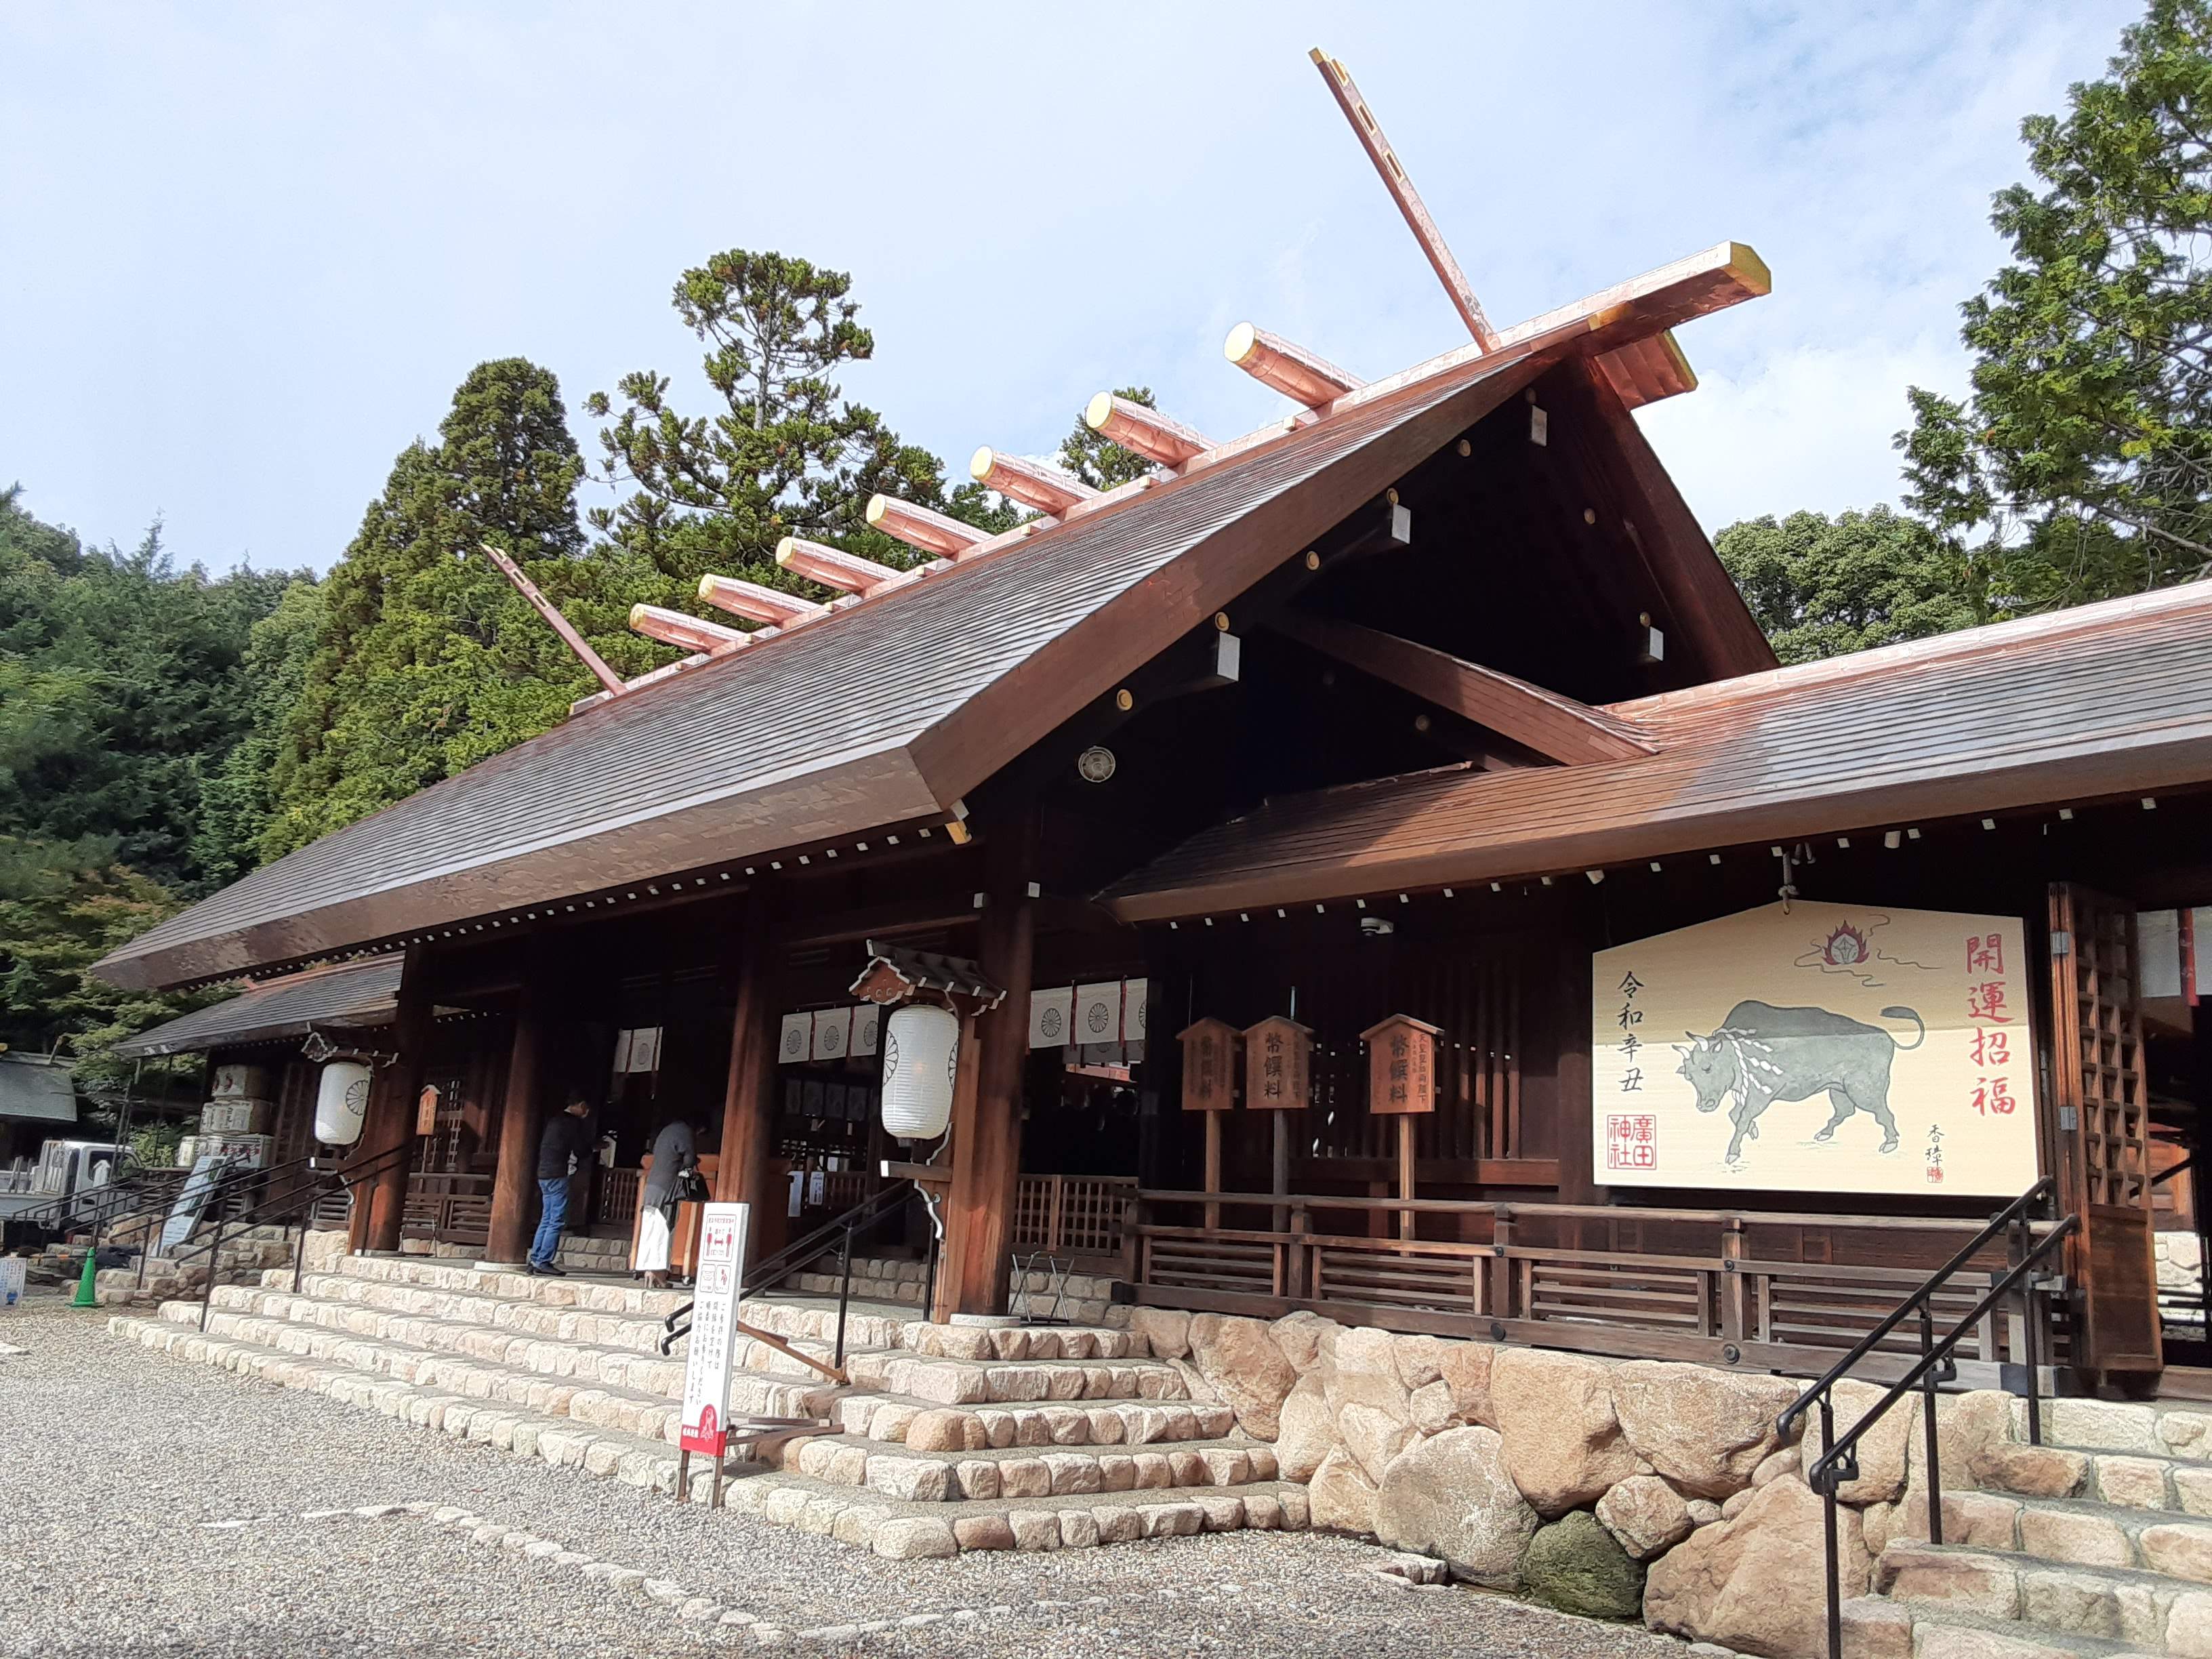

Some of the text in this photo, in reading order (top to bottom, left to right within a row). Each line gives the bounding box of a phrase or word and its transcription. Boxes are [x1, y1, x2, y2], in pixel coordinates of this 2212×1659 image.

[1617, 970, 1645, 1092] 令和辛丑
[1966, 933, 2015, 1116] 開運招福
[1263, 1032, 1284, 1101] 幣饌料
[1610, 1116, 1632, 1168] 神社
[1630, 1117, 1654, 1167] 廣田
